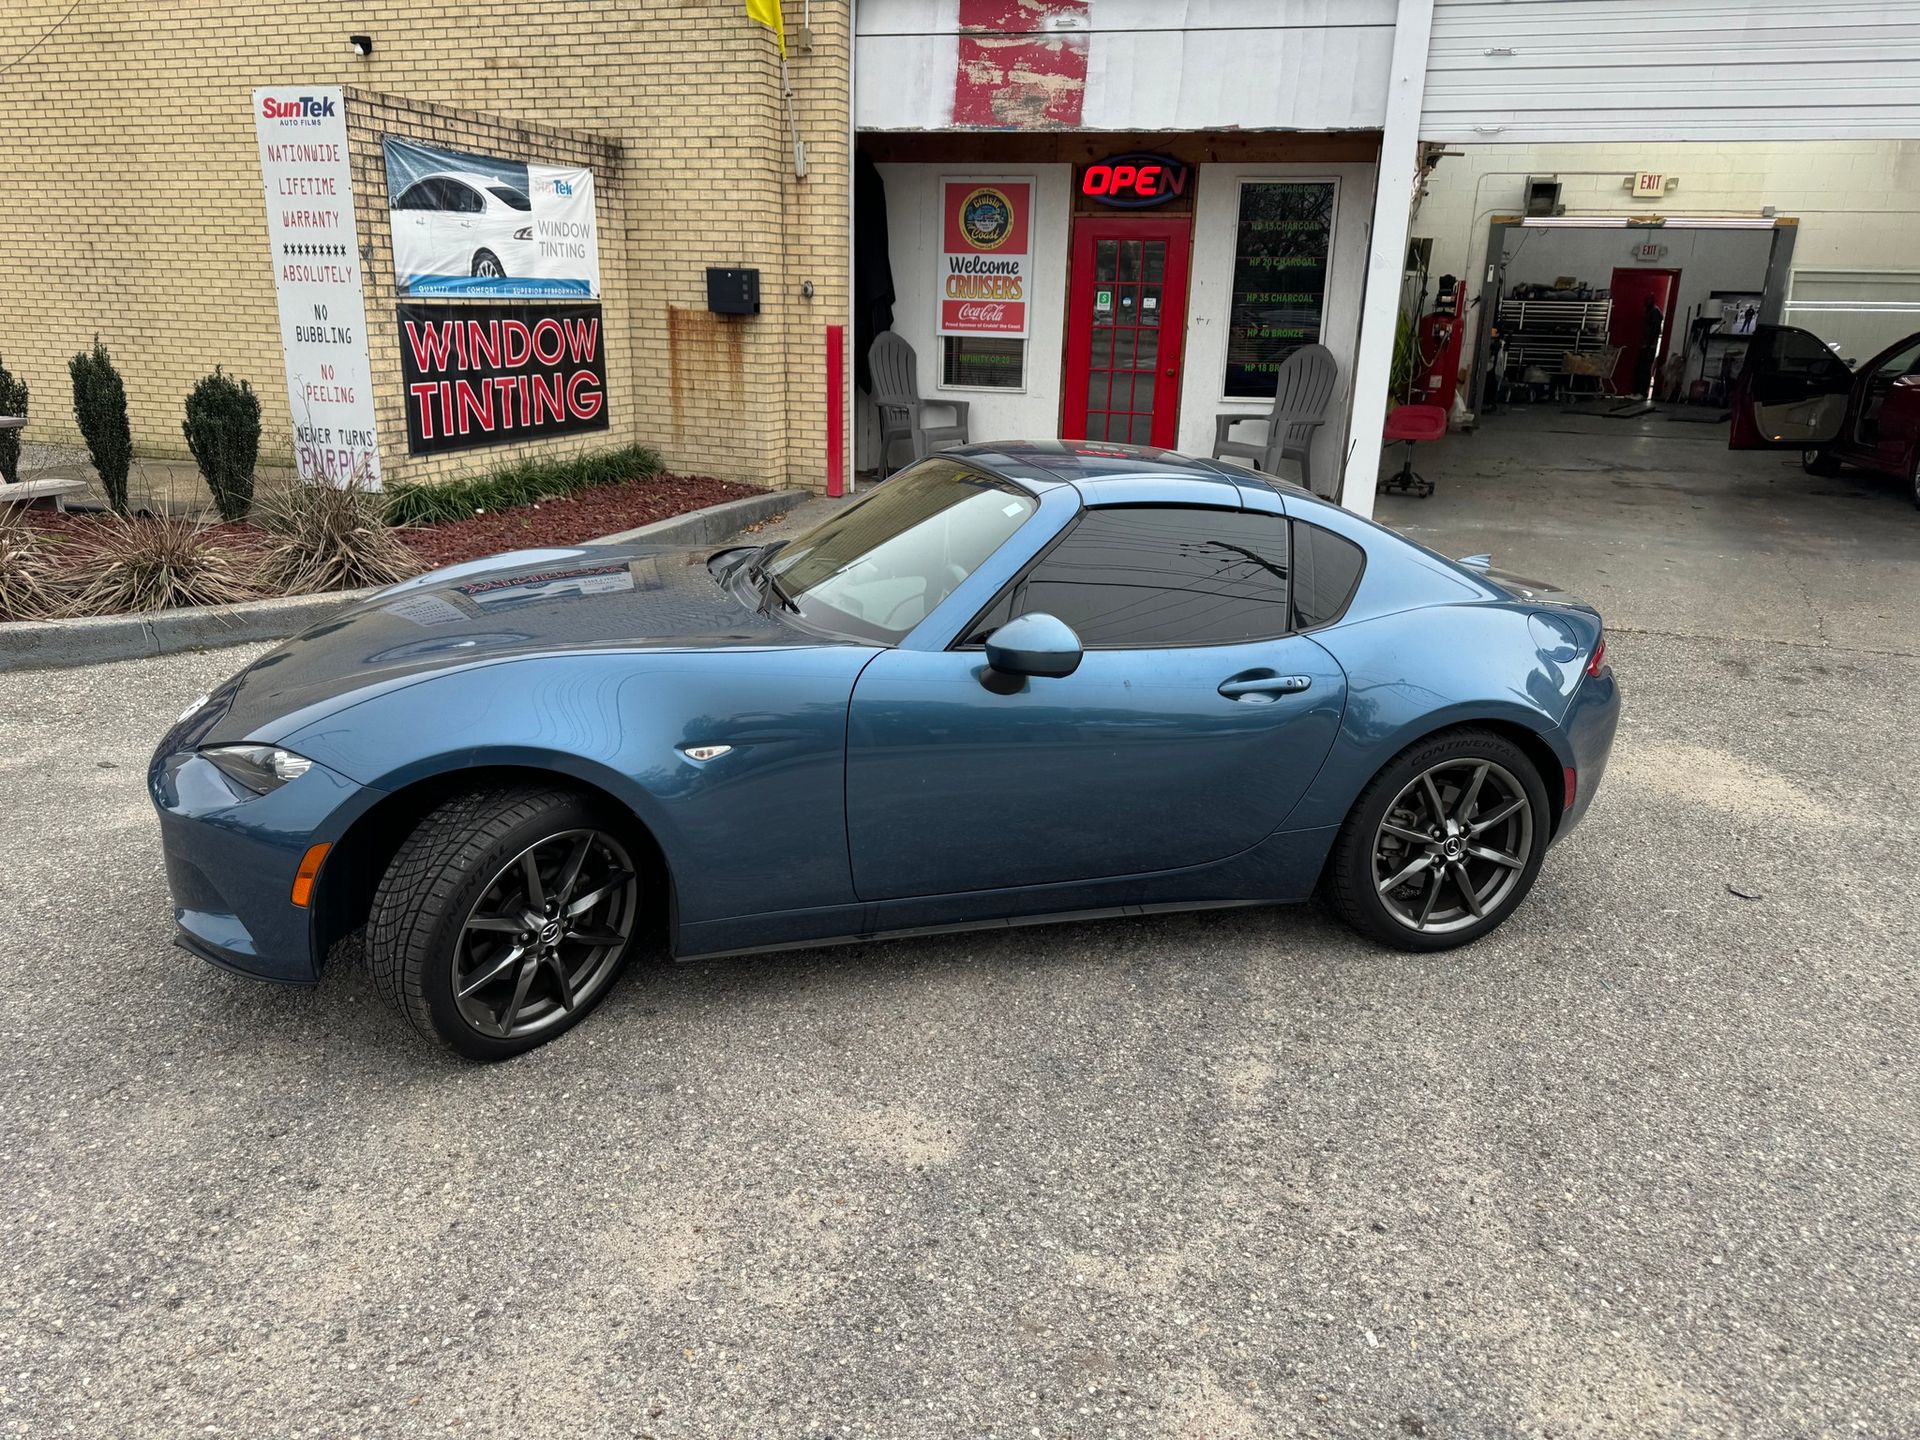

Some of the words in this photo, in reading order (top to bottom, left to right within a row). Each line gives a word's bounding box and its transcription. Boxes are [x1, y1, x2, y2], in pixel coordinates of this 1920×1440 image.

[262, 96, 335, 118] SunTek
[268, 144, 340, 162] NATIONWIDE
[279, 178, 336, 195] LIFETIME
[1082, 165, 1187, 195] OPEN
[1640, 175, 1662, 190] EXIT
[282, 211, 339, 228] WARRANTY
[538, 220, 590, 239] WINDOW
[971, 228, 1000, 240] Coast
[539, 241, 586, 259] TINTING
[1642, 245, 1656, 255] EXIT
[949, 255, 1019, 274] Welcome
[1249, 257, 1260, 266] HP
[1263, 257, 1271, 266] 20
[1273, 258, 1317, 267] CHARCOAL
[283, 265, 352, 283] ABSOLUTELY
[466, 286, 497, 294] COMFORT
[945, 274, 1022, 300] CRUISERS
[1247, 293, 1257, 302] HP
[1260, 293, 1269, 302] 35
[1271, 293, 1313, 302] CHARCOAL
[314, 304, 328, 321] NO
[958, 303, 1007, 321] Coca-Cola
[296, 325, 352, 344] BUBBLING
[1247, 329, 1258, 337] HP
[1261, 329, 1269, 337] 40
[1271, 329, 1304, 338] BRONZE
[404, 318, 599, 373] WINDOW
[320, 364, 335, 380] NO
[1244, 363, 1255, 372] HP
[1258, 363, 1267, 372] 18
[306, 385, 355, 403] PEELING
[410, 370, 602, 439] TINTING
[298, 427, 332, 444] NEVER
[338, 429, 373, 447] TURNS
[1411, 740, 1518, 767] CONTINENTAL
